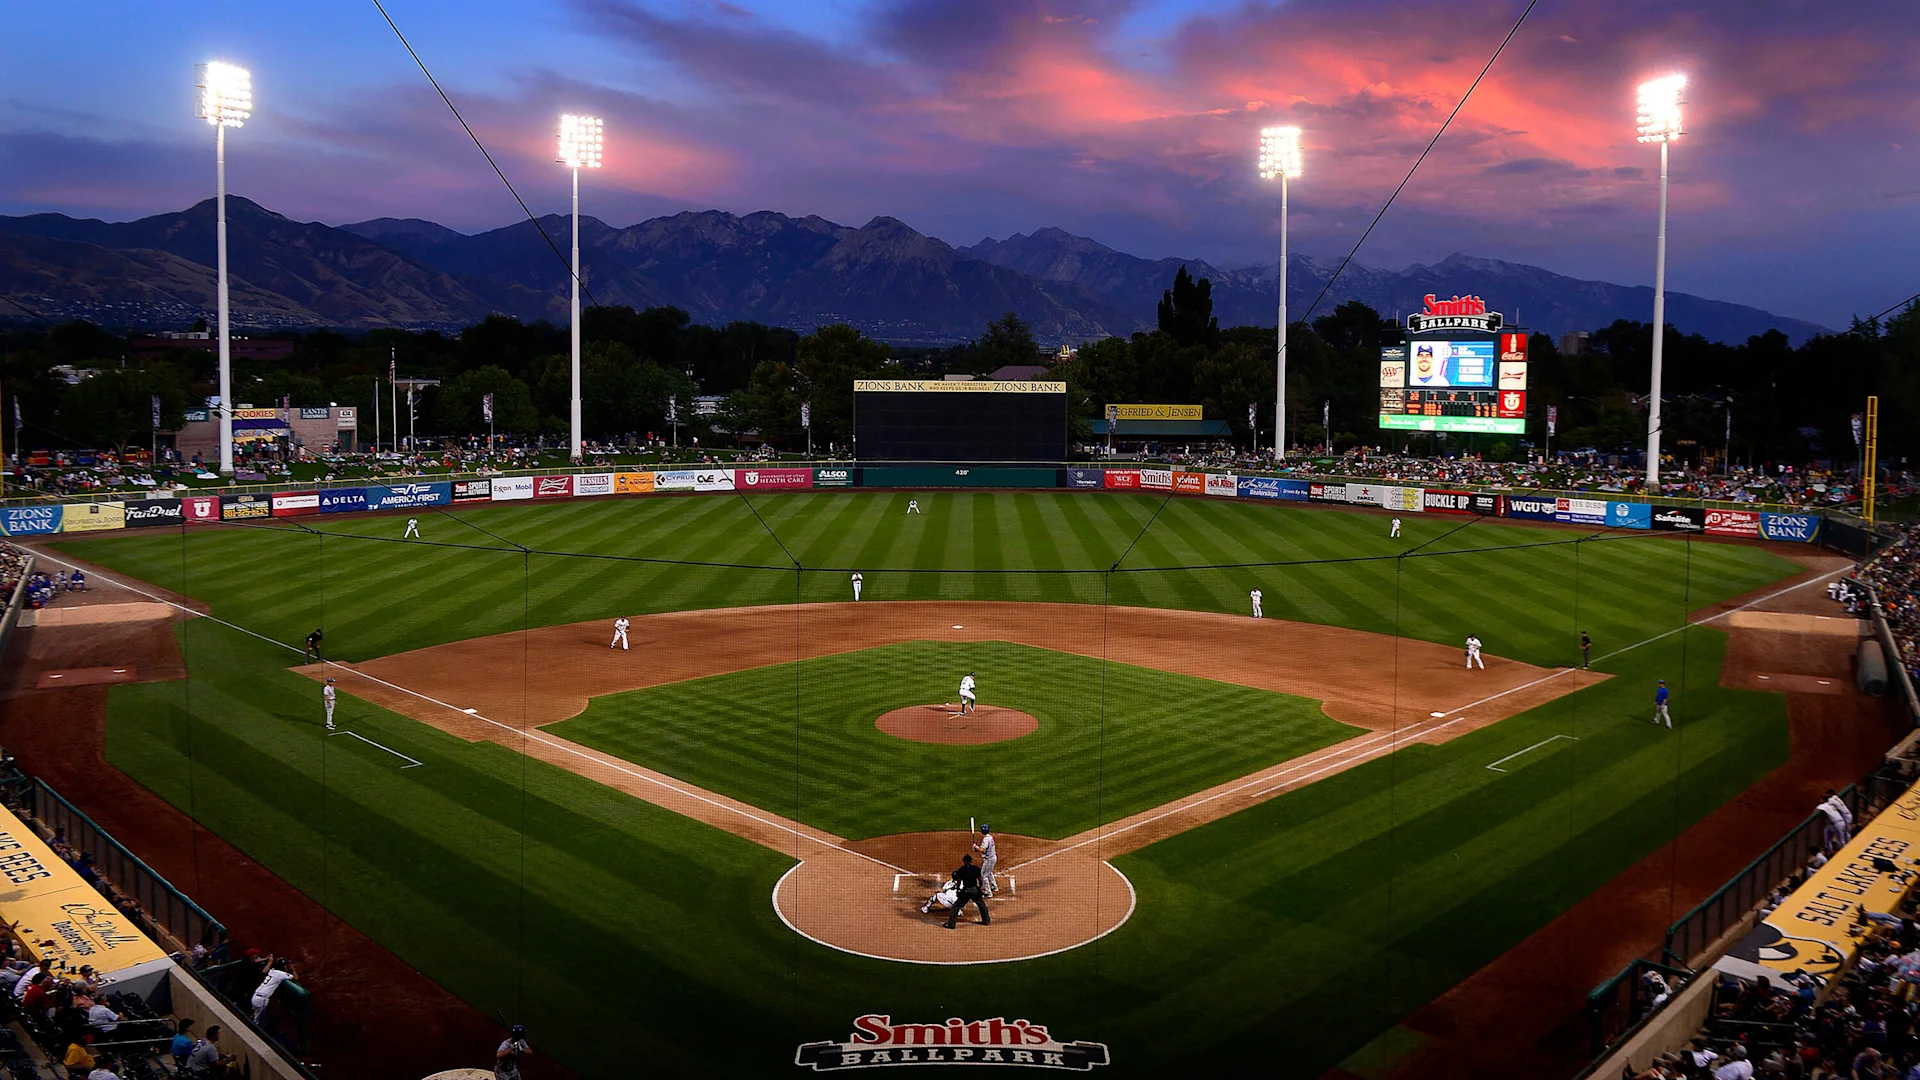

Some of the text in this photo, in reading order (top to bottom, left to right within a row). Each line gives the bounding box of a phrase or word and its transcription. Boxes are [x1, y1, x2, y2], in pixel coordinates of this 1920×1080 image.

[1423, 294, 1485, 316] Smith's
[1419, 318, 1489, 330] BALLPARK
[857, 381, 925, 391] ZIONS BANK
[993, 382, 1061, 392] ZIONS BANK
[1107, 406, 1201, 418] SEGFRIED & JENSEN
[818, 470, 848, 478] ALSCO
[1141, 469, 1172, 484] Smith's
[493, 484, 512, 494] Exxon
[515, 483, 532, 491] Mobil
[1323, 486, 1346, 495] SPORTS
[332, 495, 365, 505] DELTA
[380, 493, 441, 505] AMERICA FIRST
[1425, 493, 1456, 508] BUCKLE
[1458, 496, 1470, 509] UP
[125, 504, 182, 521] FanDuel
[1510, 500, 1541, 513] WGU
[8, 507, 53, 520] ZIONS
[1654, 513, 1692, 524] Safelite
[9, 519, 53, 532] BANK
[1767, 515, 1808, 527] ZIONS
[1767, 525, 1807, 539] BANK
[1826, 862, 1881, 896] LAKE
[1795, 891, 1854, 927] SALT
[851, 1014, 1050, 1046] Smith's
[840, 1048, 1065, 1067] BALLPARK
